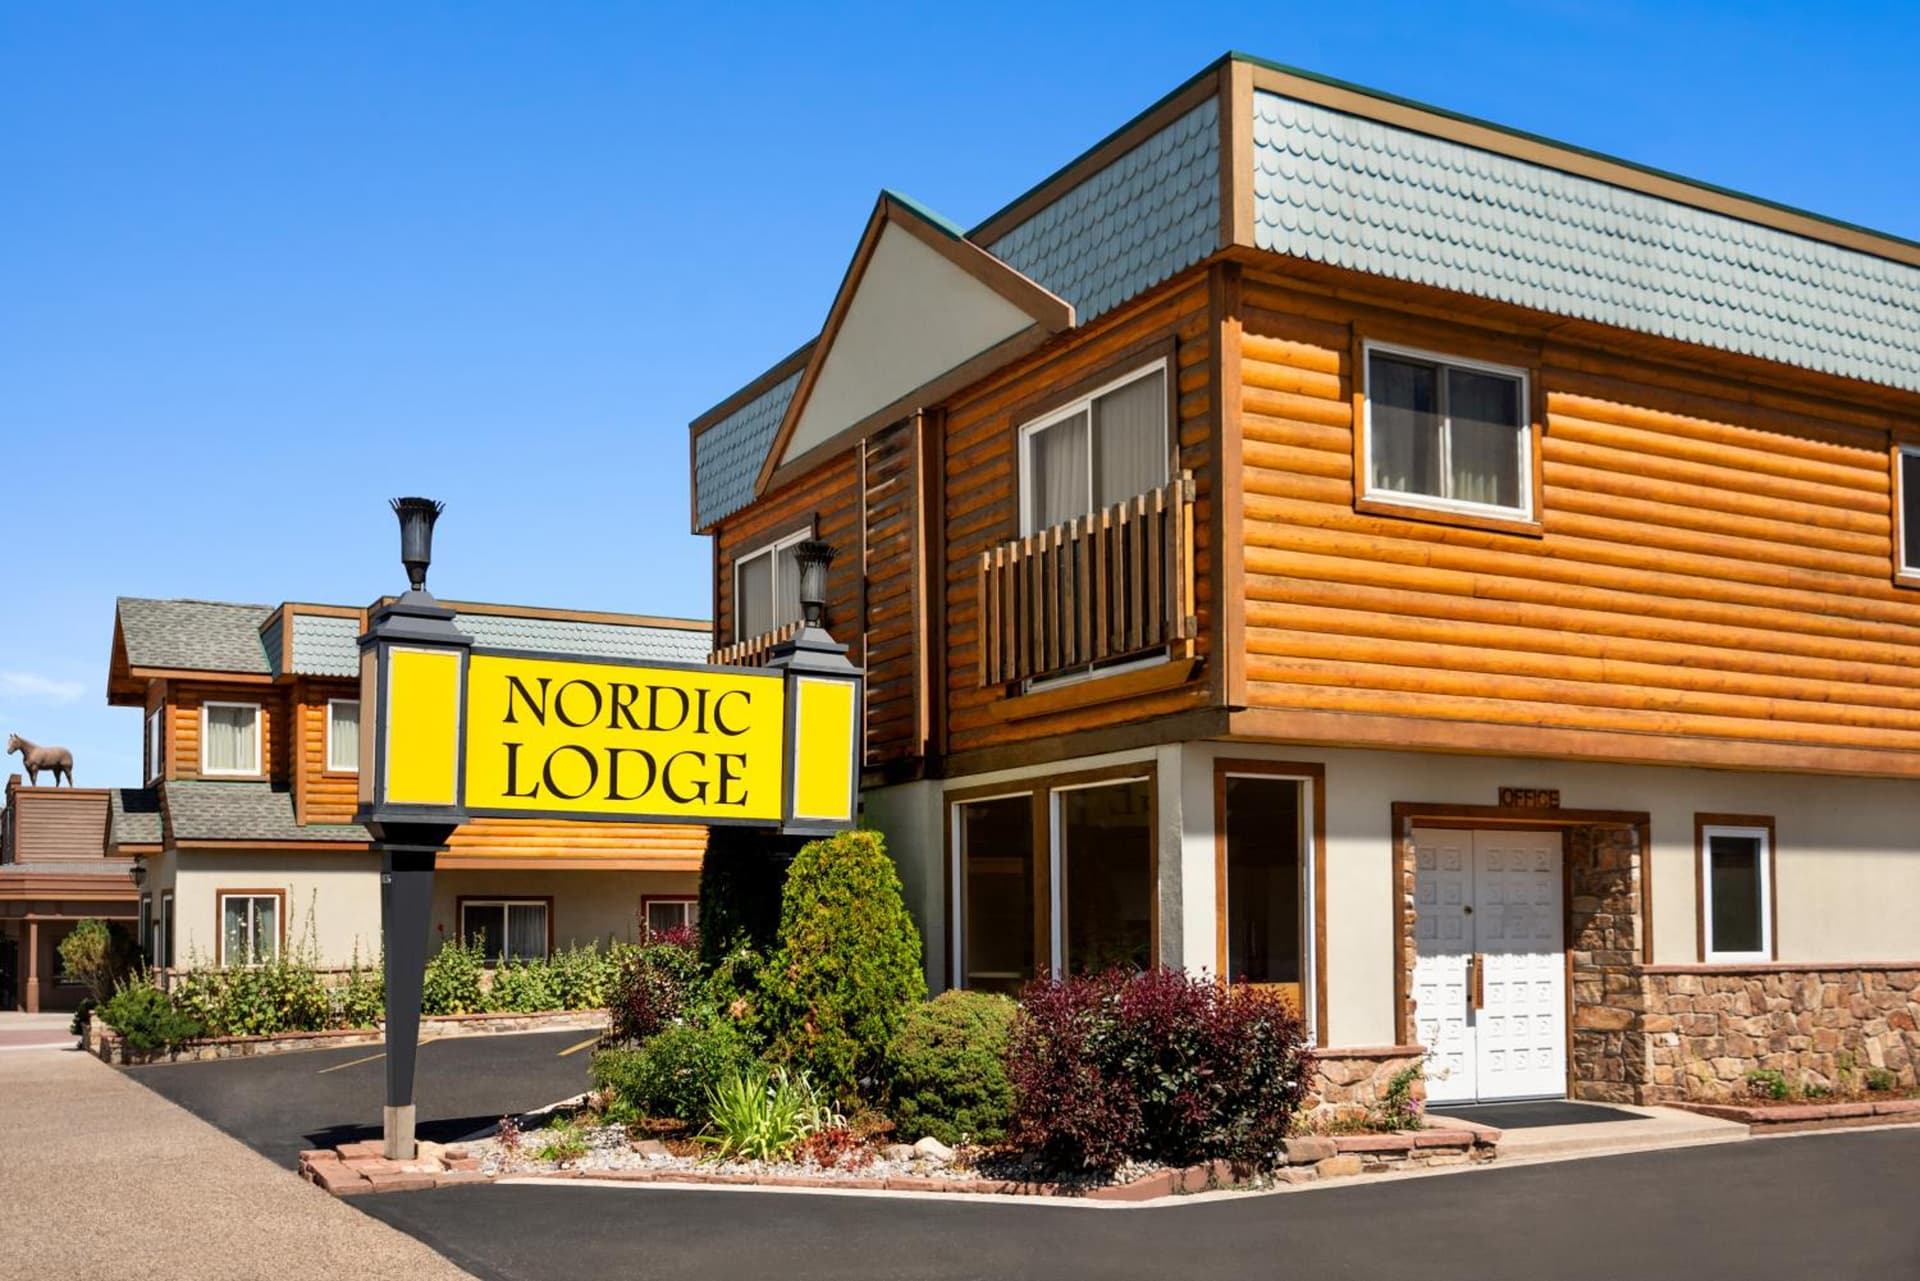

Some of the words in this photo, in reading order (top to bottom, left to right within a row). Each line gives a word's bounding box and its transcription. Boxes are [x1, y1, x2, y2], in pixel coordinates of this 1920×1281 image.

[502, 675, 751, 736] NORDIC
[502, 742, 748, 806] LODGE
[1502, 787, 1560, 809] OFFICE
